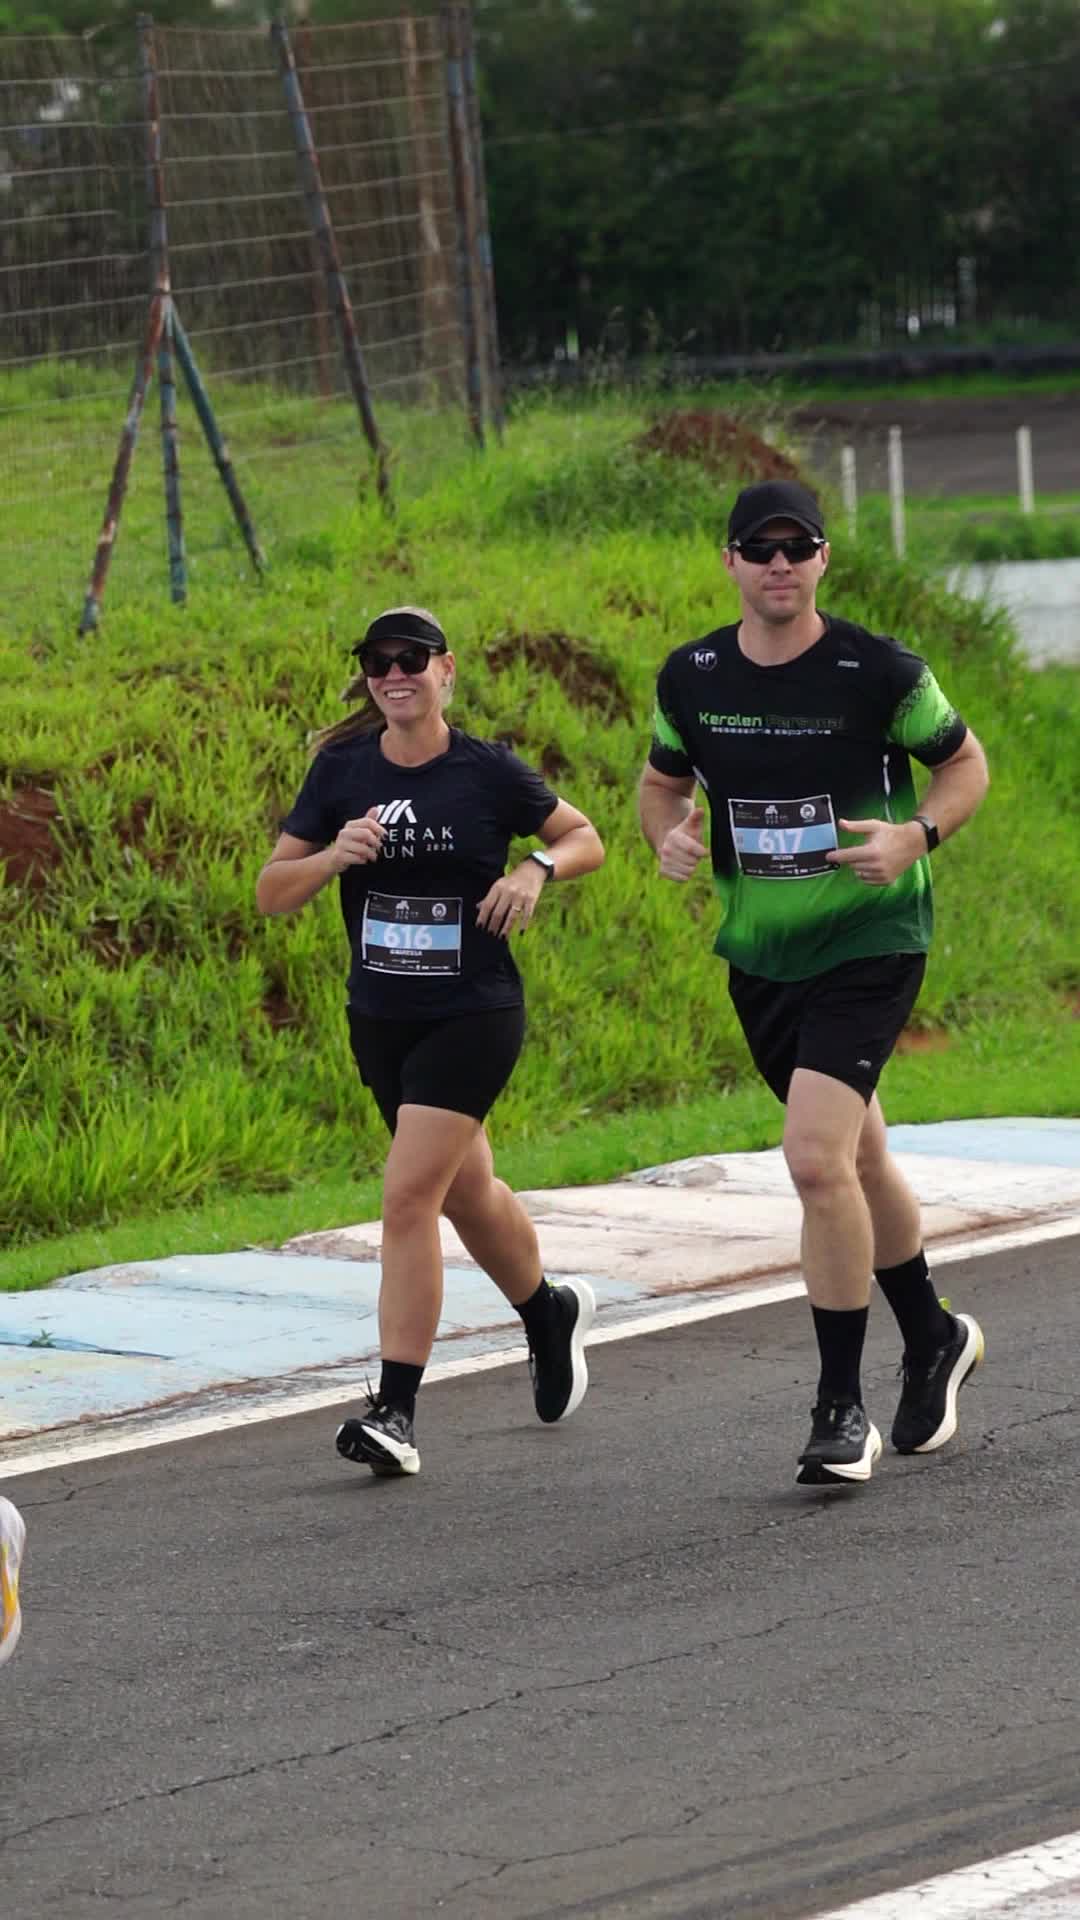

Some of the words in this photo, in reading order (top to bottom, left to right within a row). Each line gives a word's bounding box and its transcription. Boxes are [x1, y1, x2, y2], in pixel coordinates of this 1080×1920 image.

[699, 712, 762, 727] Kerolen
[389, 826, 454, 842] ERAK
[758, 828, 805, 854] 617
[383, 845, 415, 859] UN
[383, 923, 433, 950] 616
